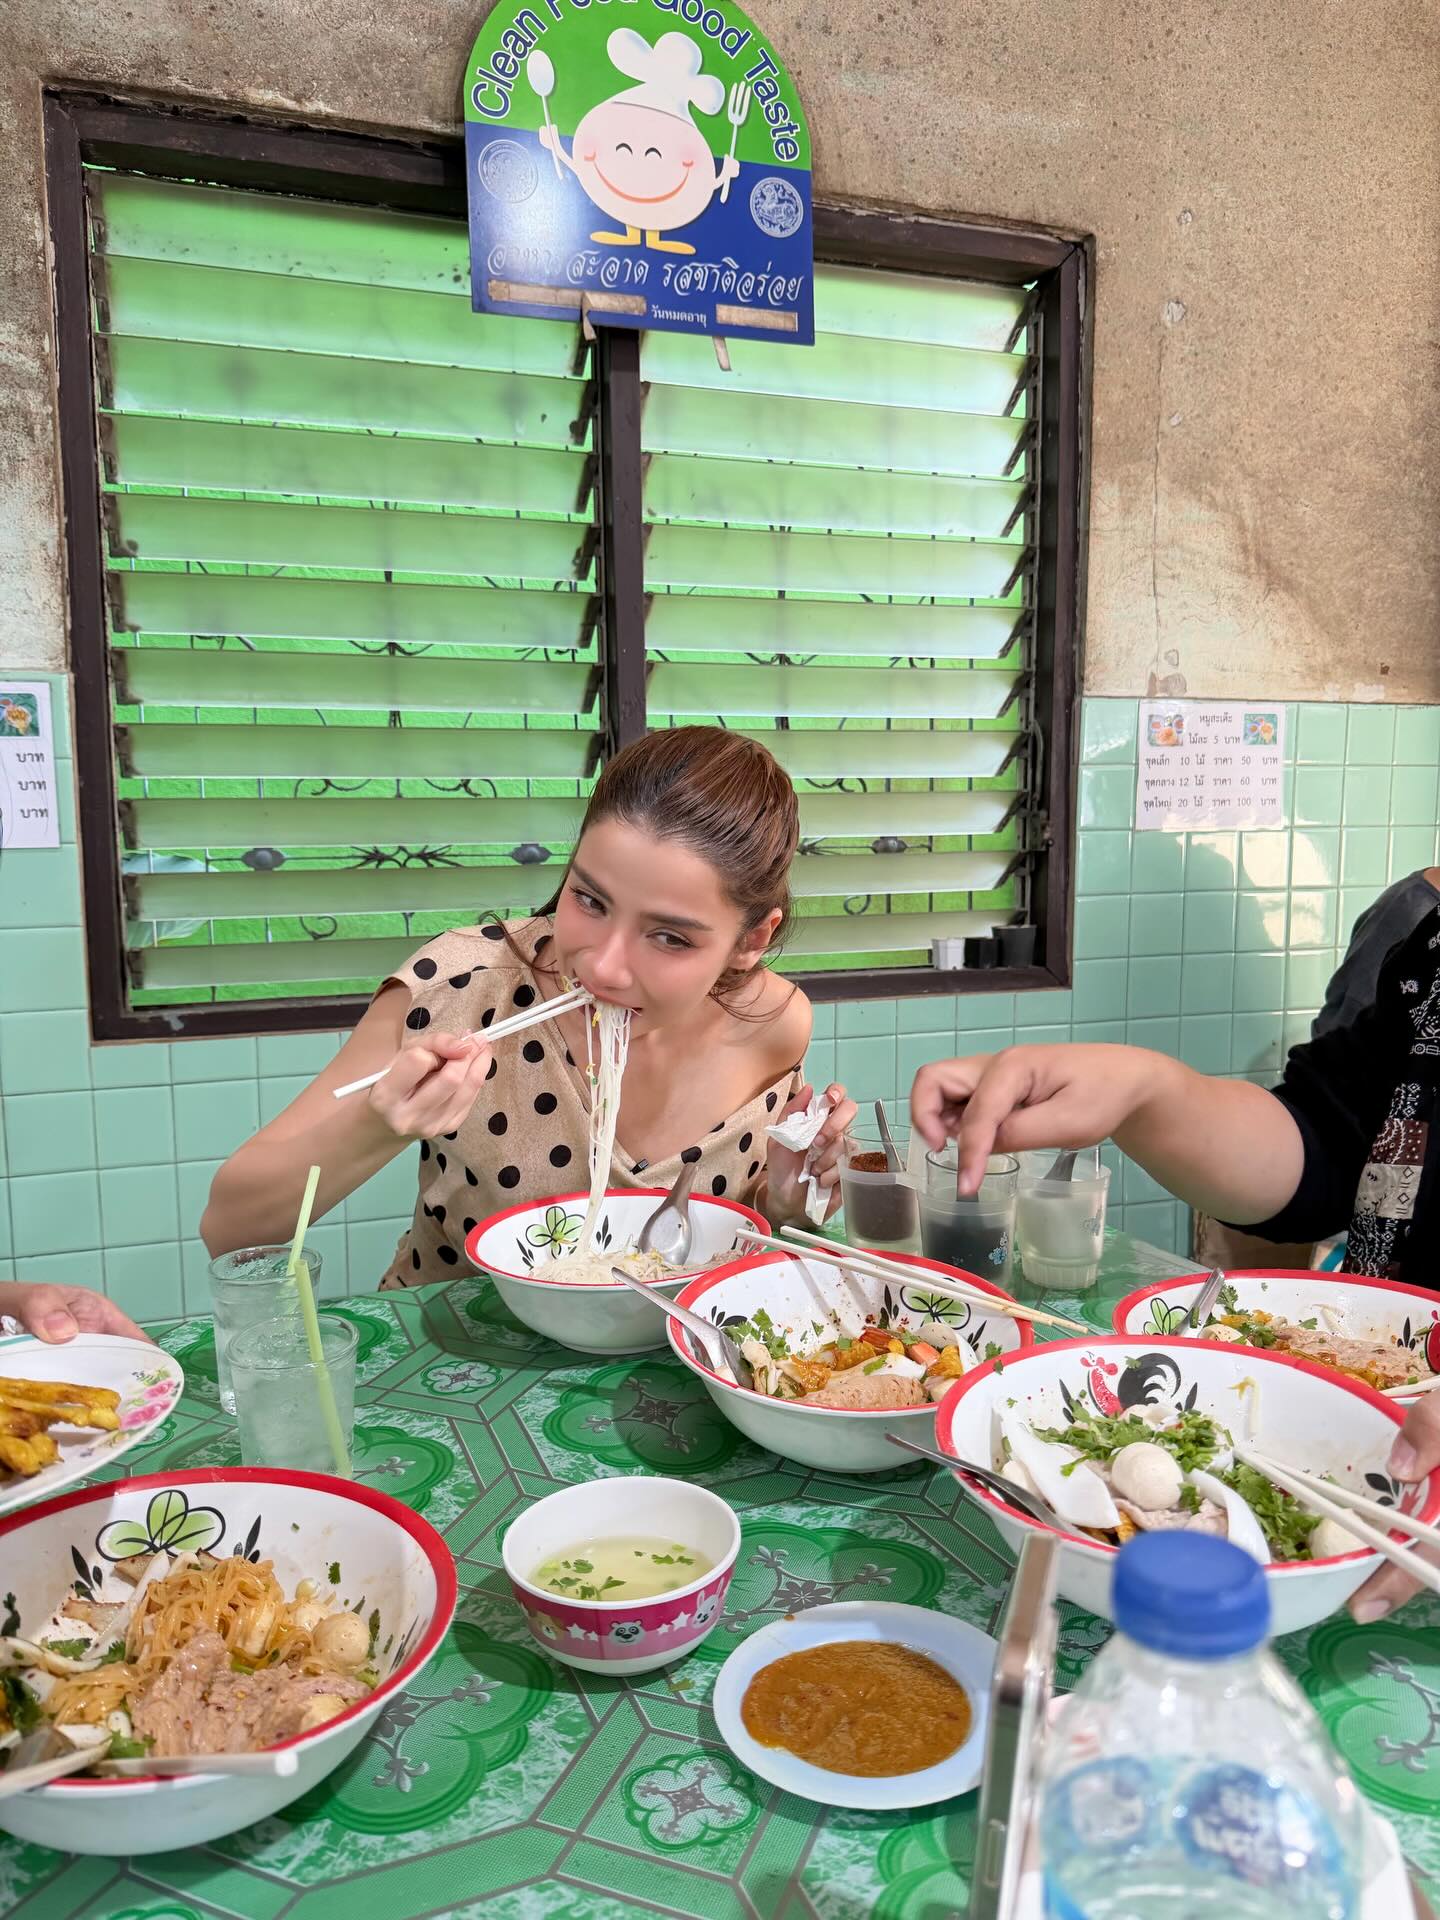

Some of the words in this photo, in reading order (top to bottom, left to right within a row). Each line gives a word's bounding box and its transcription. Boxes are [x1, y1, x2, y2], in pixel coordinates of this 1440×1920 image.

[472, 9, 548, 119] Clean
[744, 47, 800, 162] Taste
[662, 256, 804, 306] รสชาติอร่อย
[651, 304, 707, 328] วันหมดอายุ
[1213, 735, 1219, 744] 5
[1225, 735, 1241, 744] บาท
[16, 752, 45, 763] บาท
[1180, 756, 1190, 766] 10
[1213, 756, 1233, 766] ราคา
[1241, 756, 1252, 766] 50
[1262, 756, 1278, 766] บาท
[18, 780, 47, 791] บาท
[1179, 777, 1189, 787] 12
[1212, 777, 1232, 786] ราคา
[1240, 776, 1250, 786] 60
[1261, 776, 1277, 786] บาท
[1177, 798, 1188, 808] 20
[1237, 797, 1251, 807] 100
[1260, 797, 1277, 806] บาท
[20, 807, 49, 819] บาท
